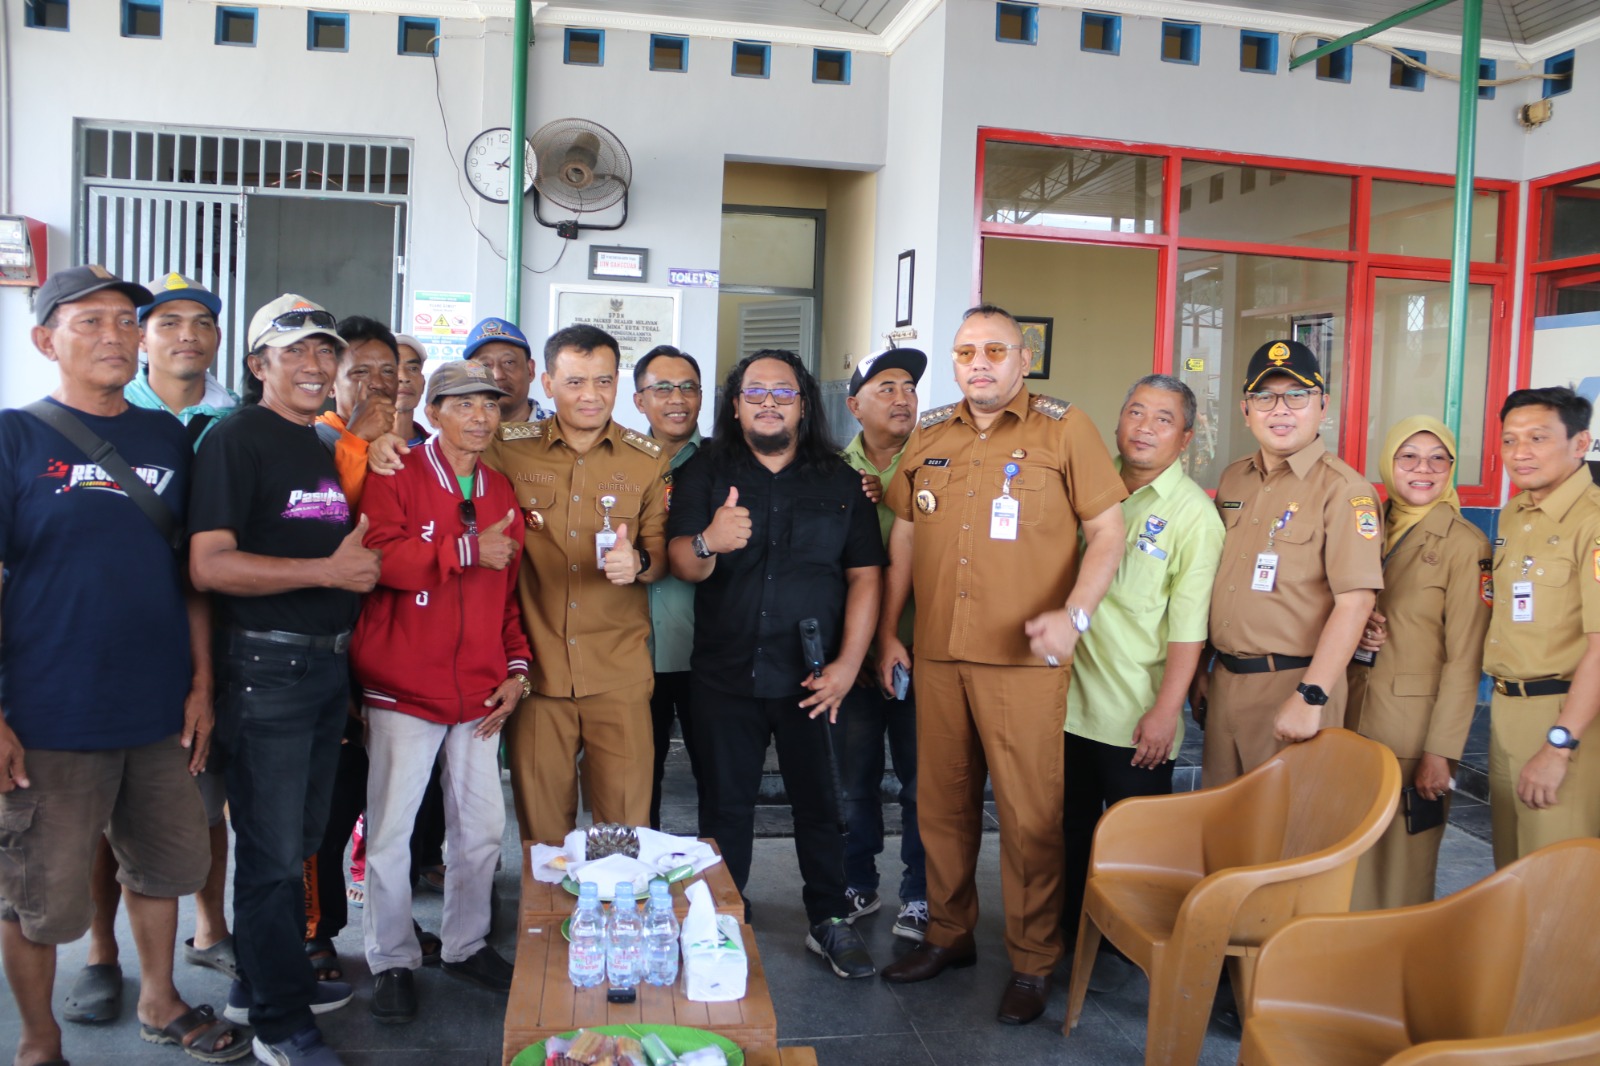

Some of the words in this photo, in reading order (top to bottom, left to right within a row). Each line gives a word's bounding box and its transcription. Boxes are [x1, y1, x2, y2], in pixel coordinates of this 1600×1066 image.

[486, 137, 494, 146] 11
[499, 134, 510, 144] 12
[476, 146, 486, 156] 10
[470, 158, 478, 168] 9
[474, 172, 482, 182] 8
[483, 182, 490, 191] 7
[496, 188, 504, 196] 6
[670, 272, 704, 284] TOILET
